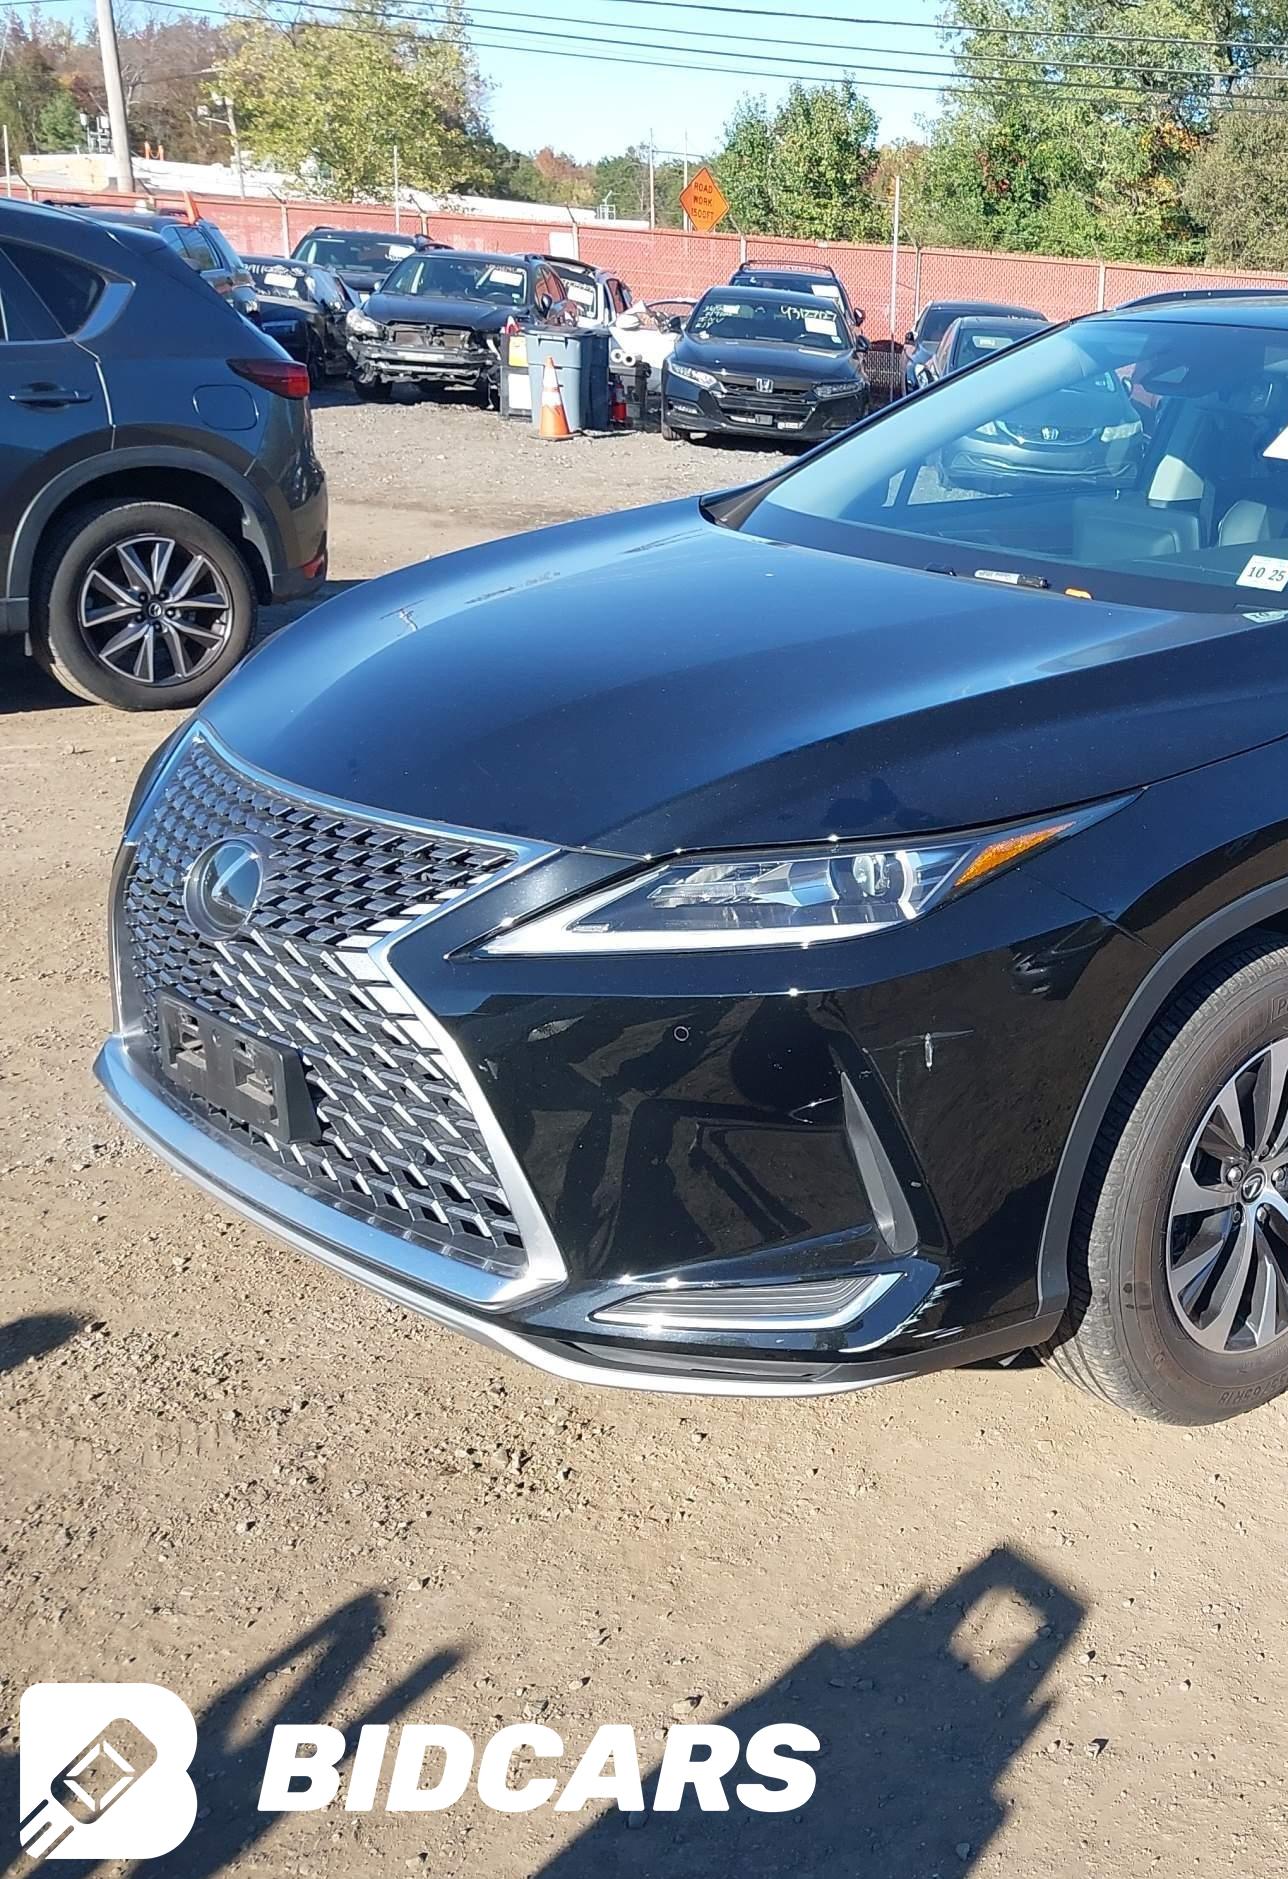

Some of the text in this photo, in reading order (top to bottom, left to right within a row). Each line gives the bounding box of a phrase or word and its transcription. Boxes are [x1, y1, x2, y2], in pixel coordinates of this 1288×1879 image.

[694, 182, 712, 193] ROAD
[693, 195, 712, 206] WORK
[1247, 566, 1287, 582] 10 25
